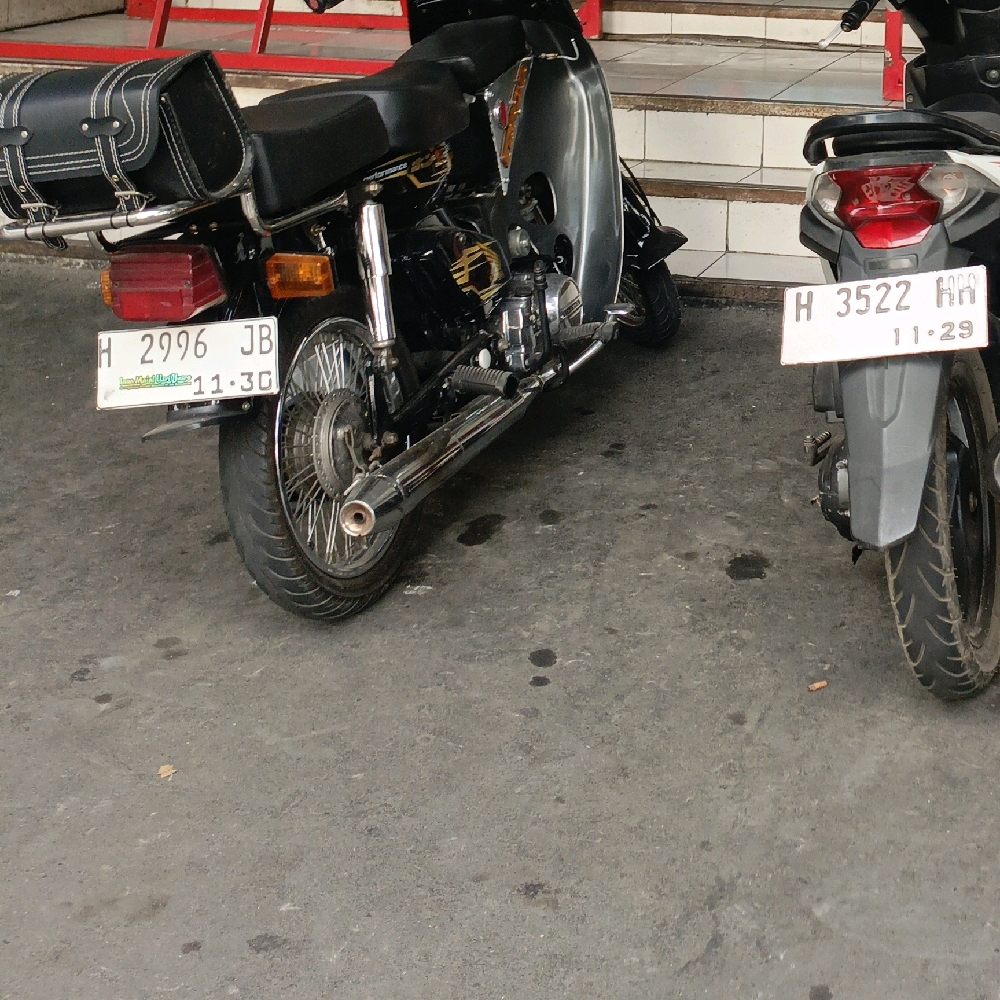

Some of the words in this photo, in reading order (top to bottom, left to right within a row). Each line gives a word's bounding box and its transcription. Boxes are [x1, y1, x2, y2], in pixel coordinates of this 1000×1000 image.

[795, 290, 813, 322] H
[837, 280, 911, 318] 3522
[936, 273, 976, 308] HH
[99, 337, 112, 368] H
[140, 328, 208, 365] 2996
[240, 324, 274, 357] JB
